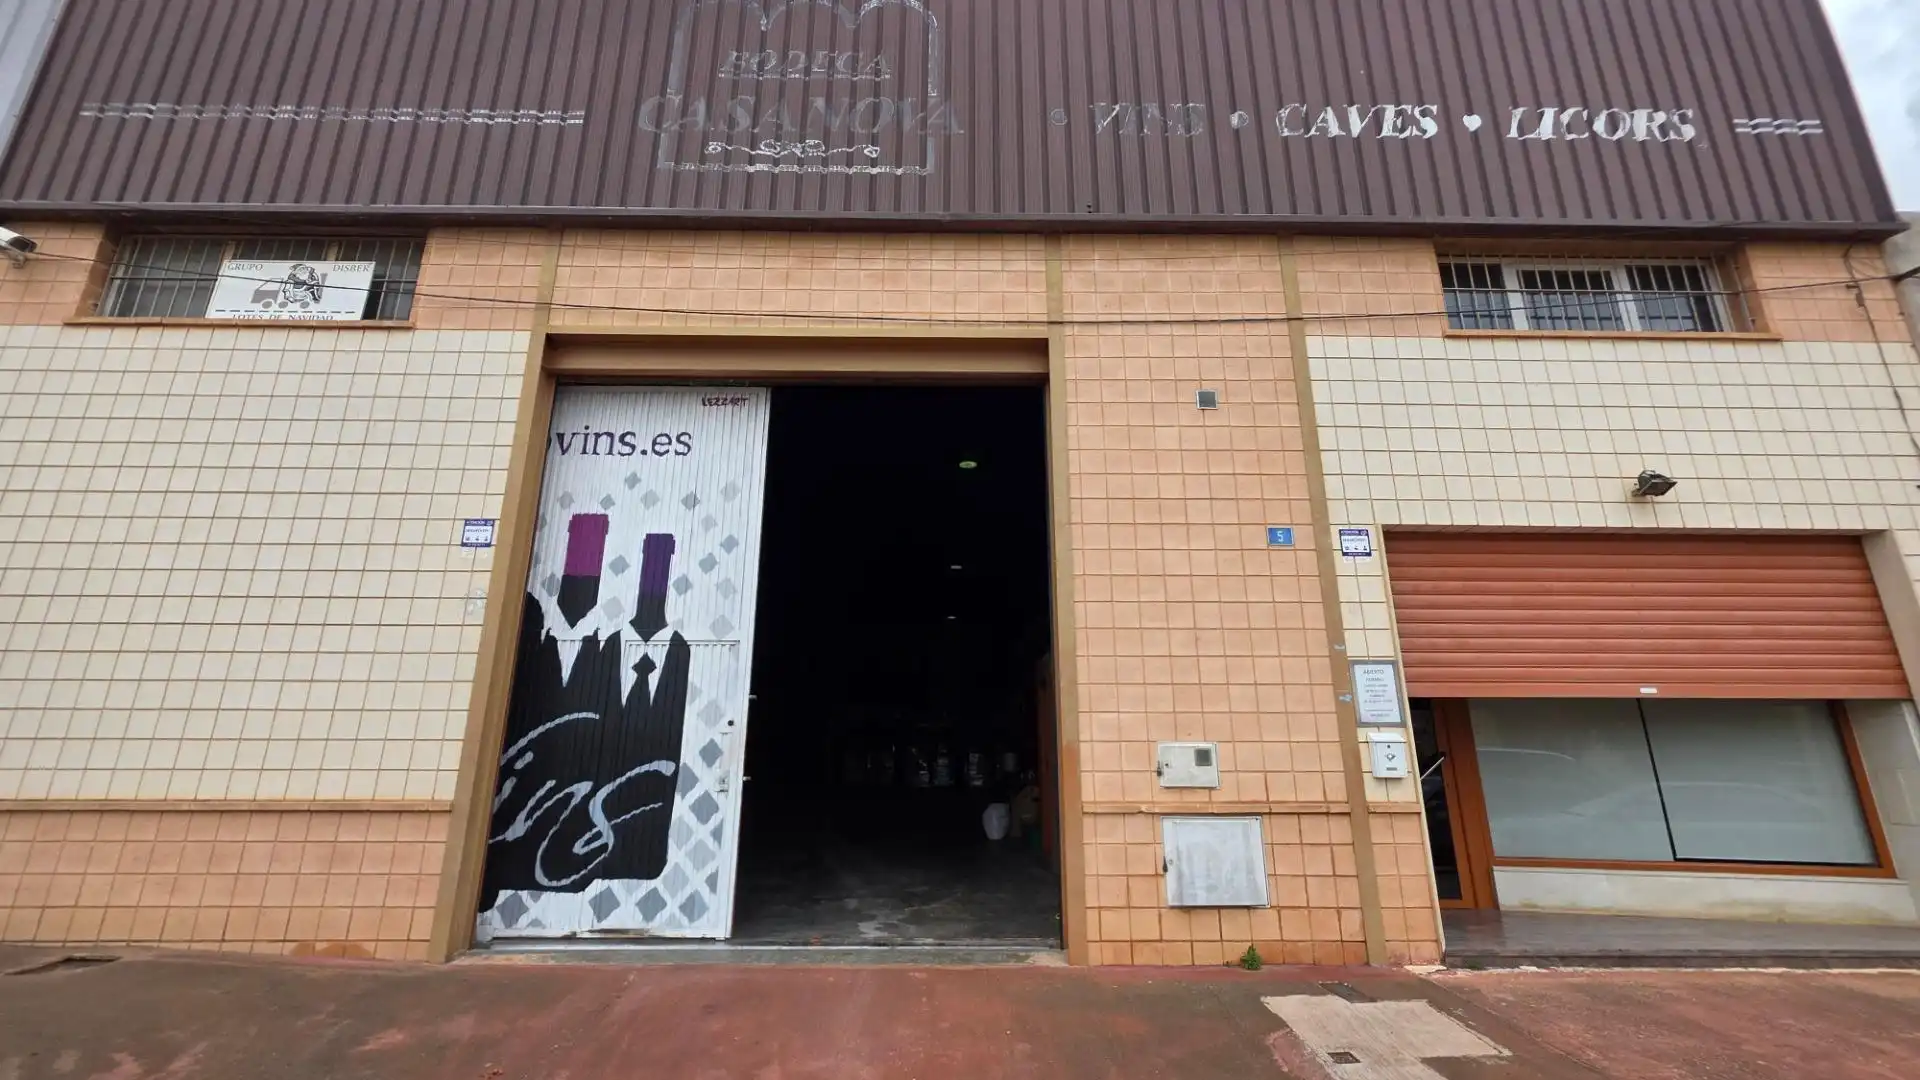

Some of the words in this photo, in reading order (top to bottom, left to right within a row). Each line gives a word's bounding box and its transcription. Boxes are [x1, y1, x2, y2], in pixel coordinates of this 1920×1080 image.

[637, 94, 965, 134] CASANOVA
[1275, 103, 1438, 139] CAVES
[1506, 106, 1697, 142] LICORS
[227, 263, 263, 271] GRUPO
[332, 264, 371, 272] DISBER
[549, 425, 692, 457] vins.es
[1277, 530, 1284, 543] 5
